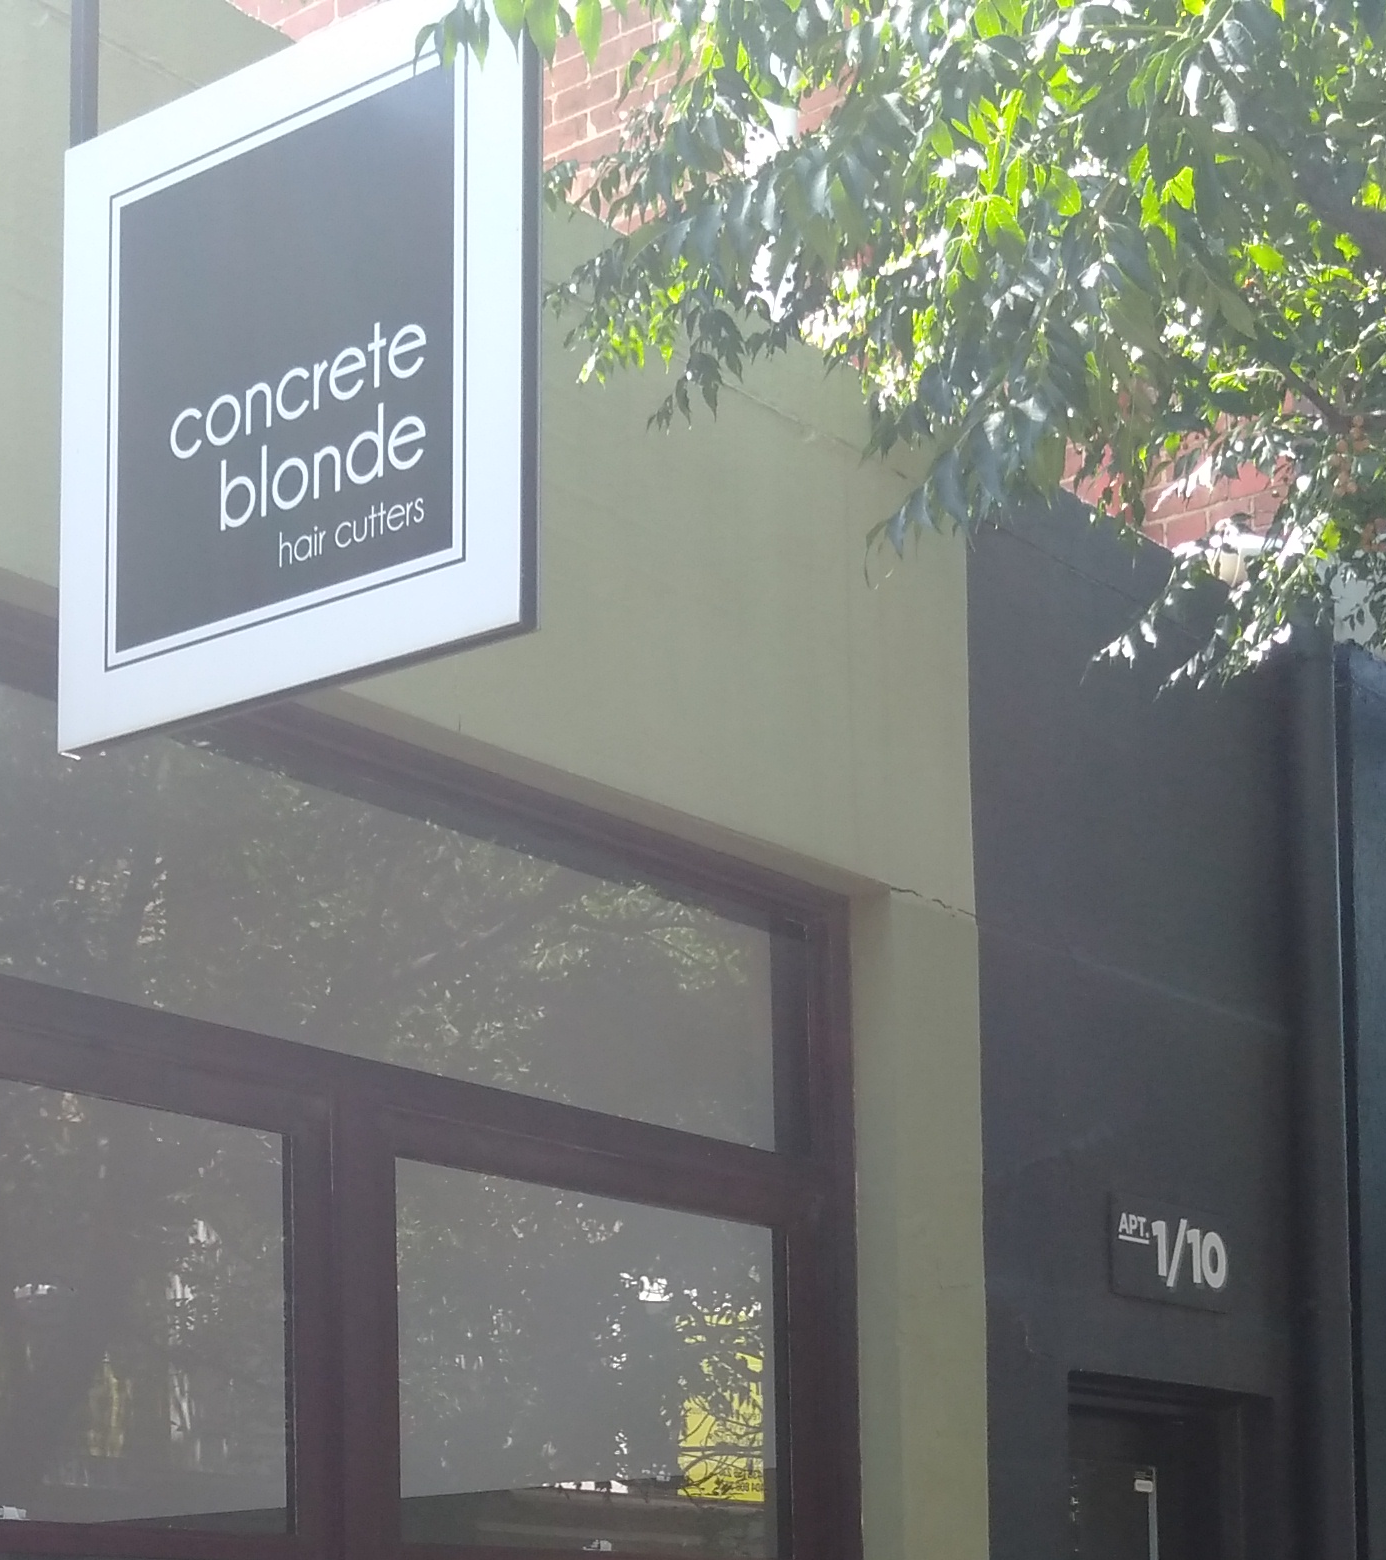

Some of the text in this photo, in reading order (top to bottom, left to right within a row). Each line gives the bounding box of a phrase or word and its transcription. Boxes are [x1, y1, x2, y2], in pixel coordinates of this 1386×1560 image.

[169, 322, 428, 460] concrete
[219, 402, 428, 531] blonde
[278, 497, 426, 568] hair cutters
[1118, 1212, 1227, 1289] APT. 1/10
